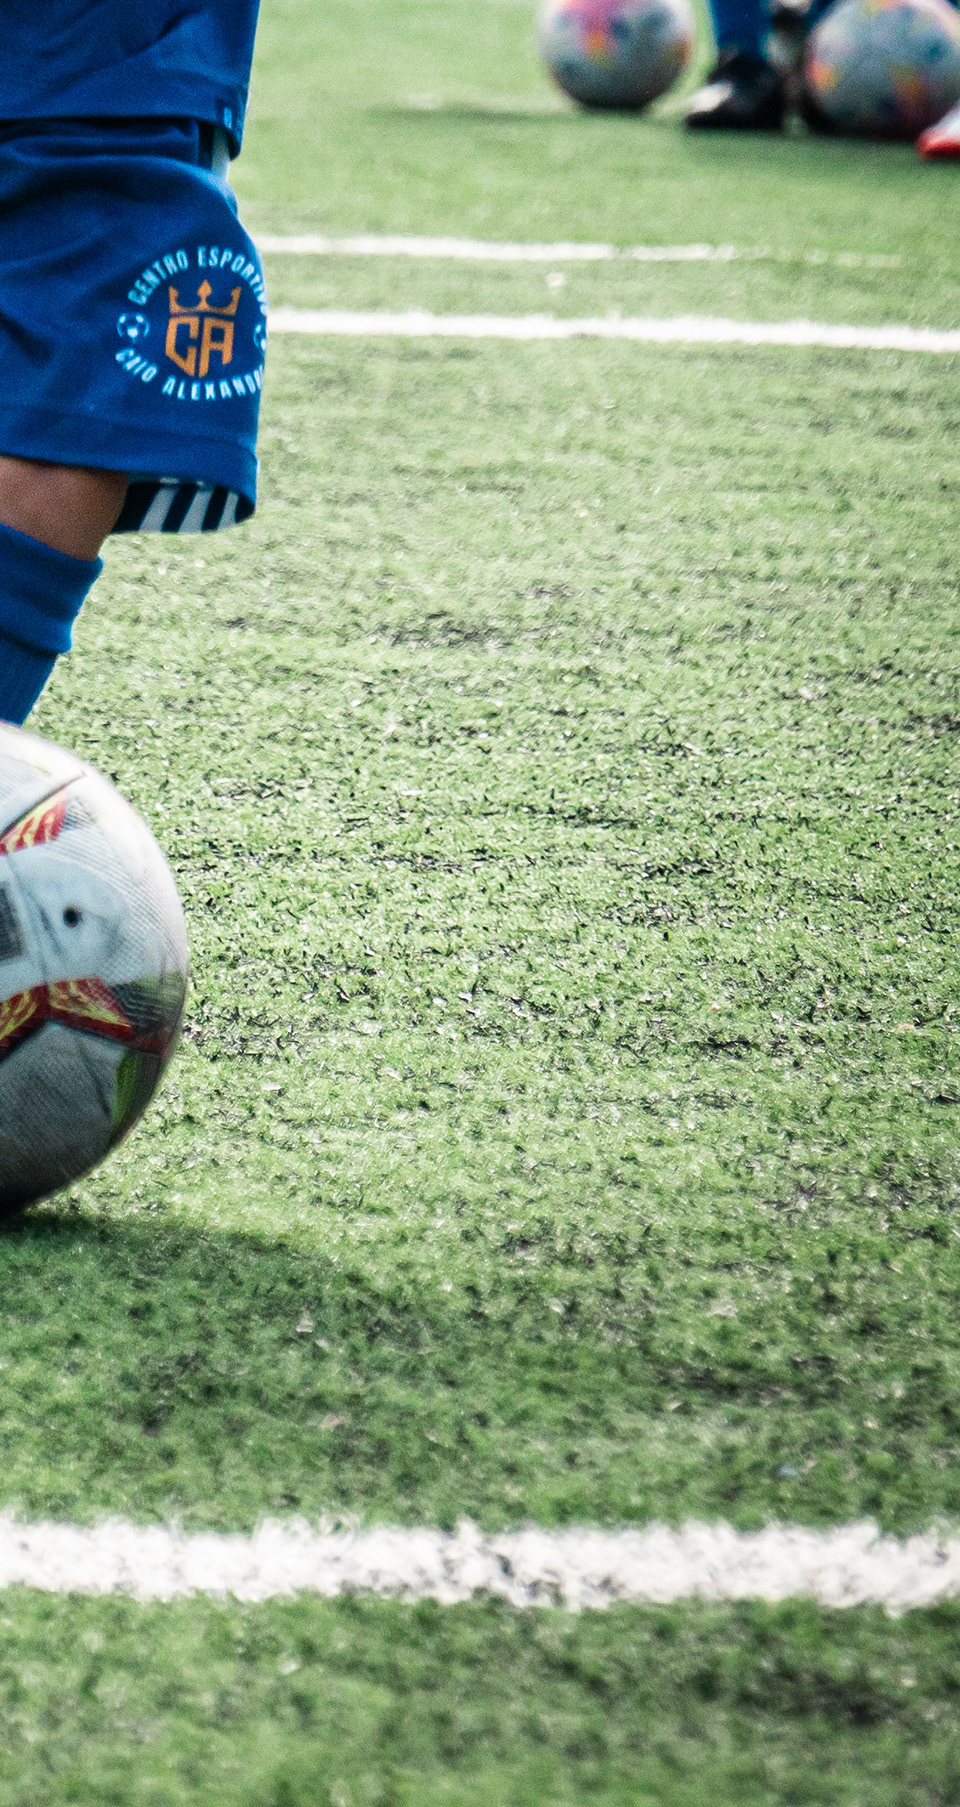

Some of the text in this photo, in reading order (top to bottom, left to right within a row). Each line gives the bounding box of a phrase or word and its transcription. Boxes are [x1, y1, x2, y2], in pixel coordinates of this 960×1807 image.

[127, 249, 190, 306] CENTRO
[115, 348, 265, 402] CAIO ALEXAND
[165, 316, 235, 379] CA
